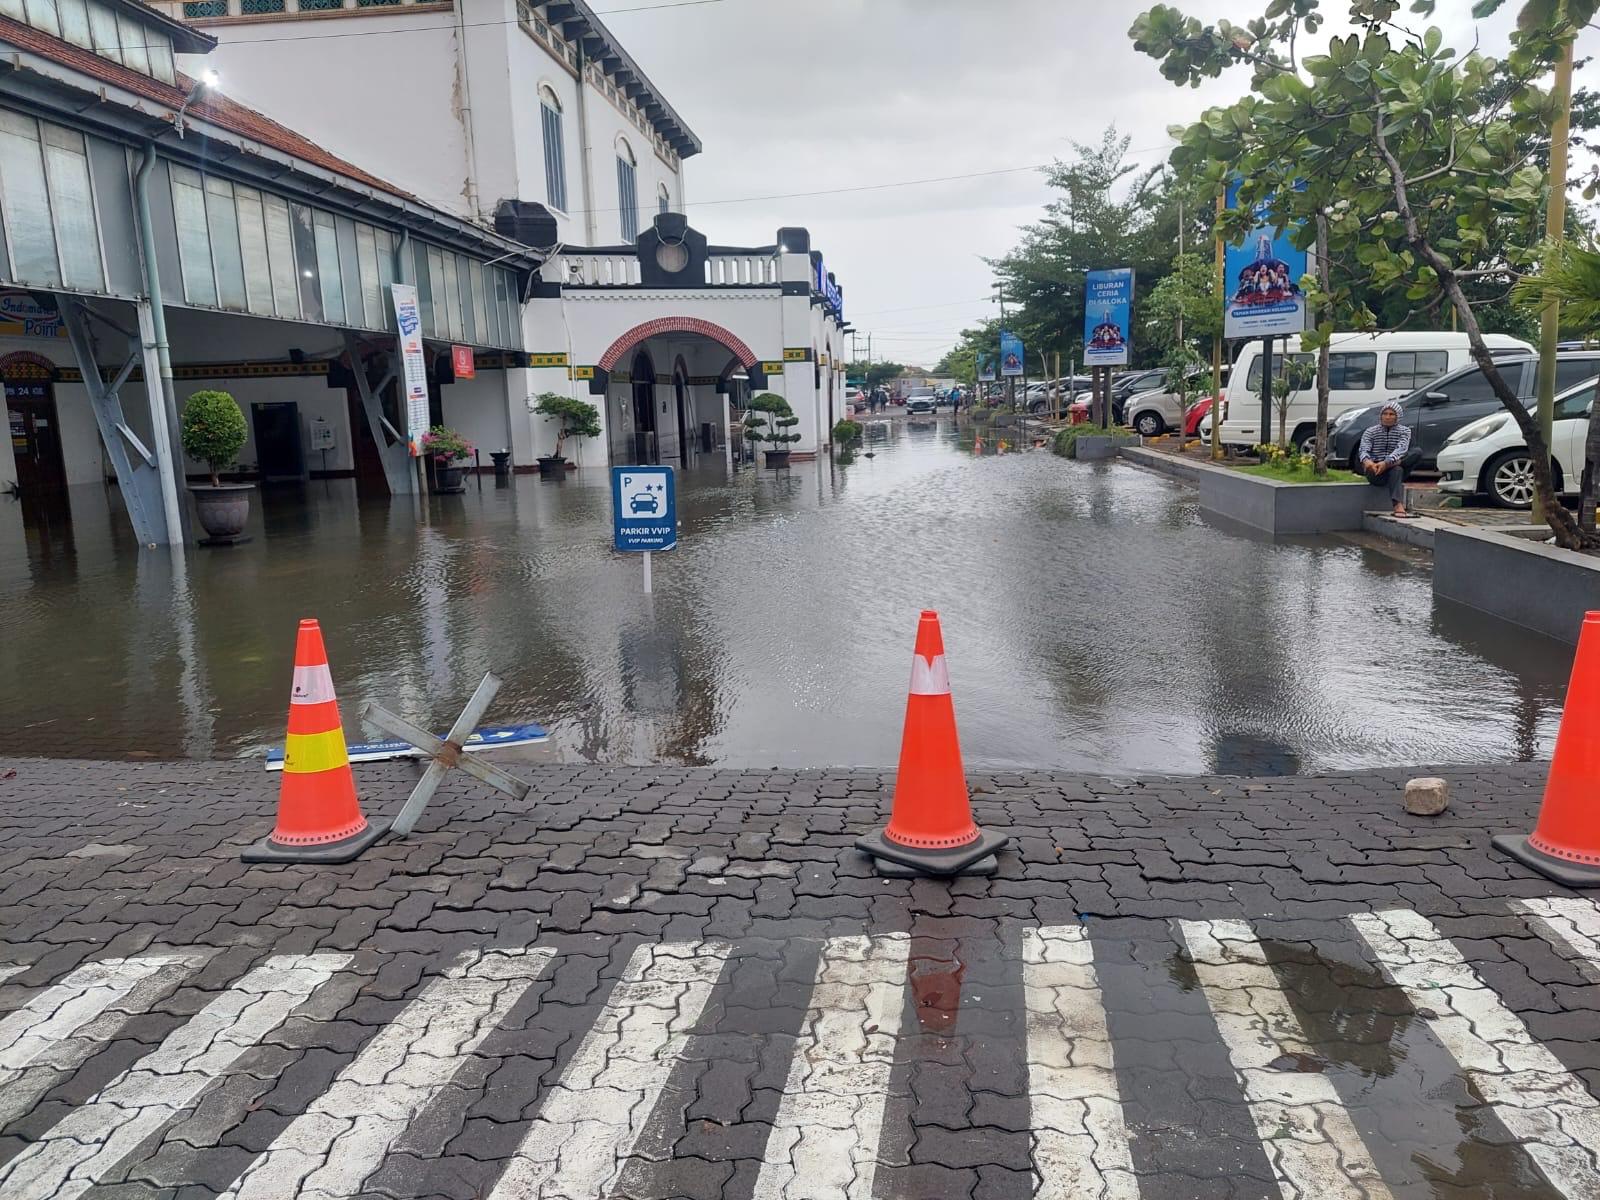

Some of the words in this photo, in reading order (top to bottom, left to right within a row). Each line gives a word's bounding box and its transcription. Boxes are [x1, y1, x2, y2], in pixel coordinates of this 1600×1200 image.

[1092, 281, 1124, 290] LIBURAN
[1096, 297, 1127, 305] SALOKA
[25, 319, 57, 336] Point
[18, 387, 29, 396] 24
[624, 477, 632, 488] P
[620, 527, 650, 536] PARKIR
[651, 527, 671, 535] VVIP
